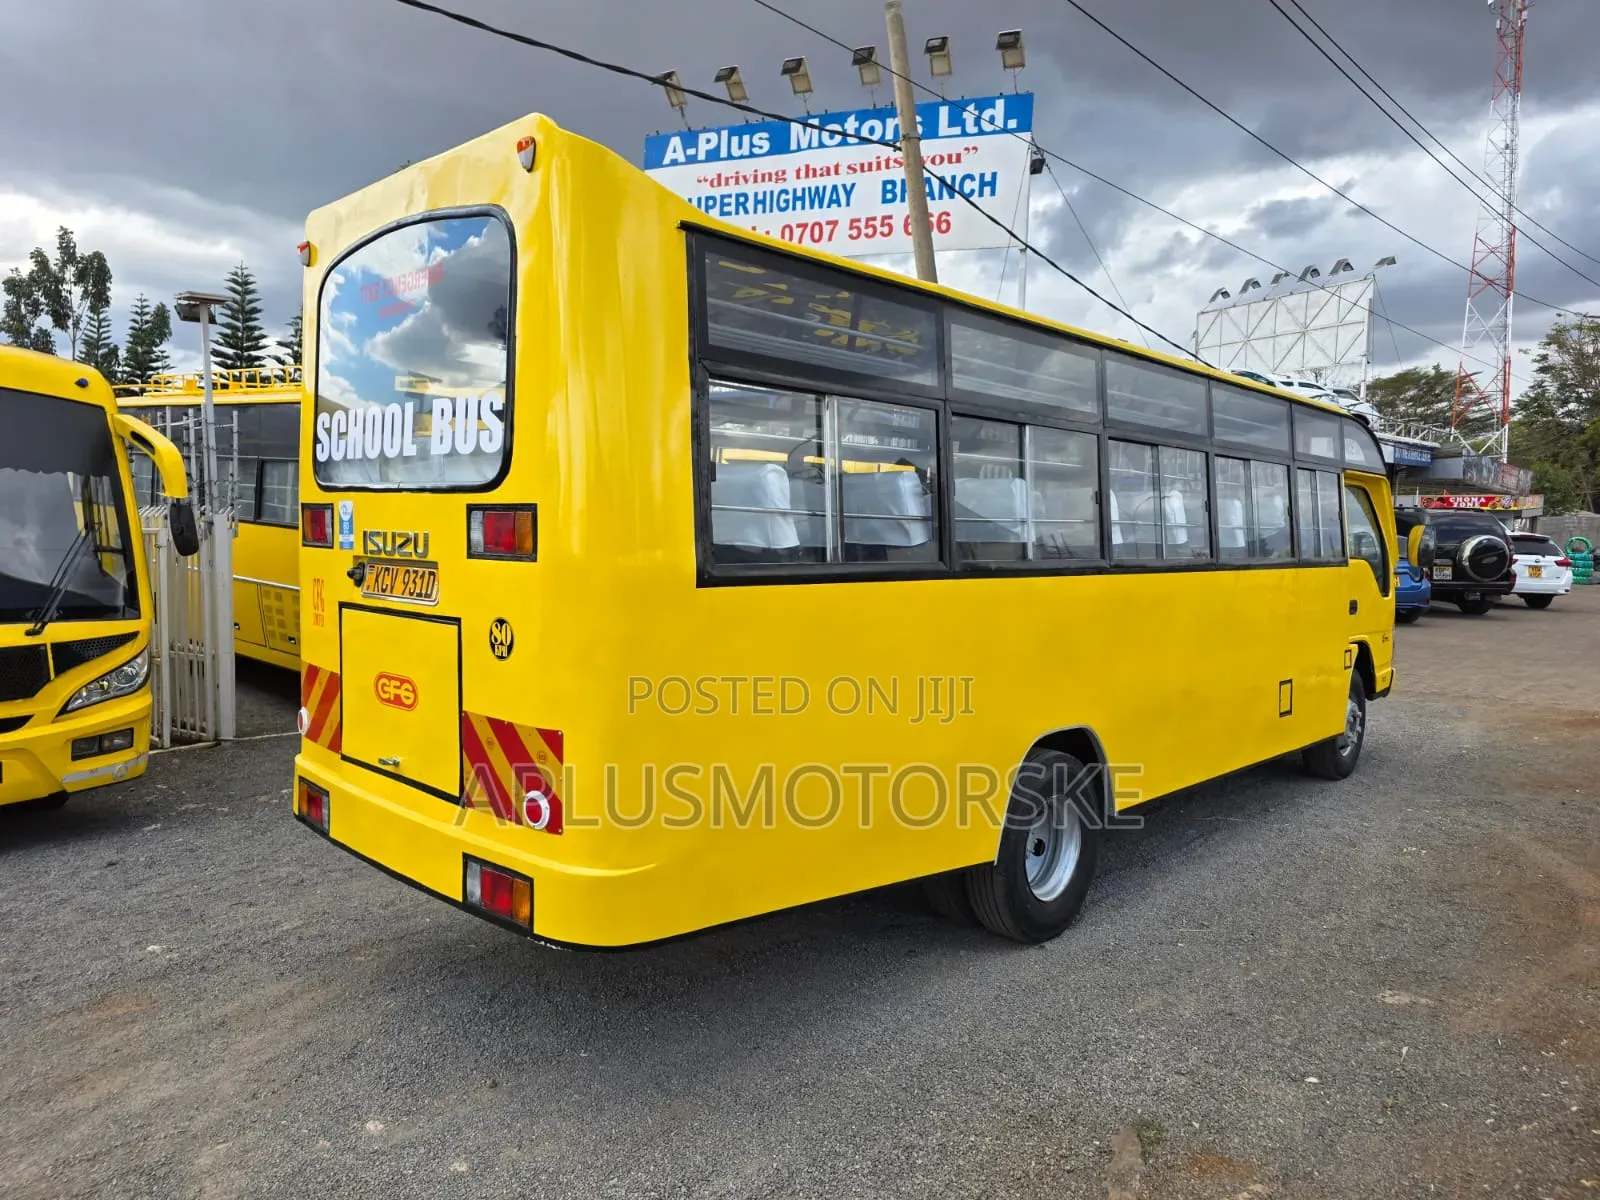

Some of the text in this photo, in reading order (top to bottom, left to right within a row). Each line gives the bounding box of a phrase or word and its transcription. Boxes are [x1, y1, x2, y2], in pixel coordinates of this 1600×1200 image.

[662, 130, 771, 166] A-Plus
[938, 98, 1018, 137] Ltd.
[795, 161, 841, 181] that
[846, 154, 905, 175] suits
[780, 219, 839, 245] 0707
[848, 214, 895, 241] 555
[316, 391, 505, 462] SCHOOL BUS
[362, 531, 429, 558] ISUZU
[373, 566, 436, 599] KCV 931D
[491, 622, 512, 646] 80
